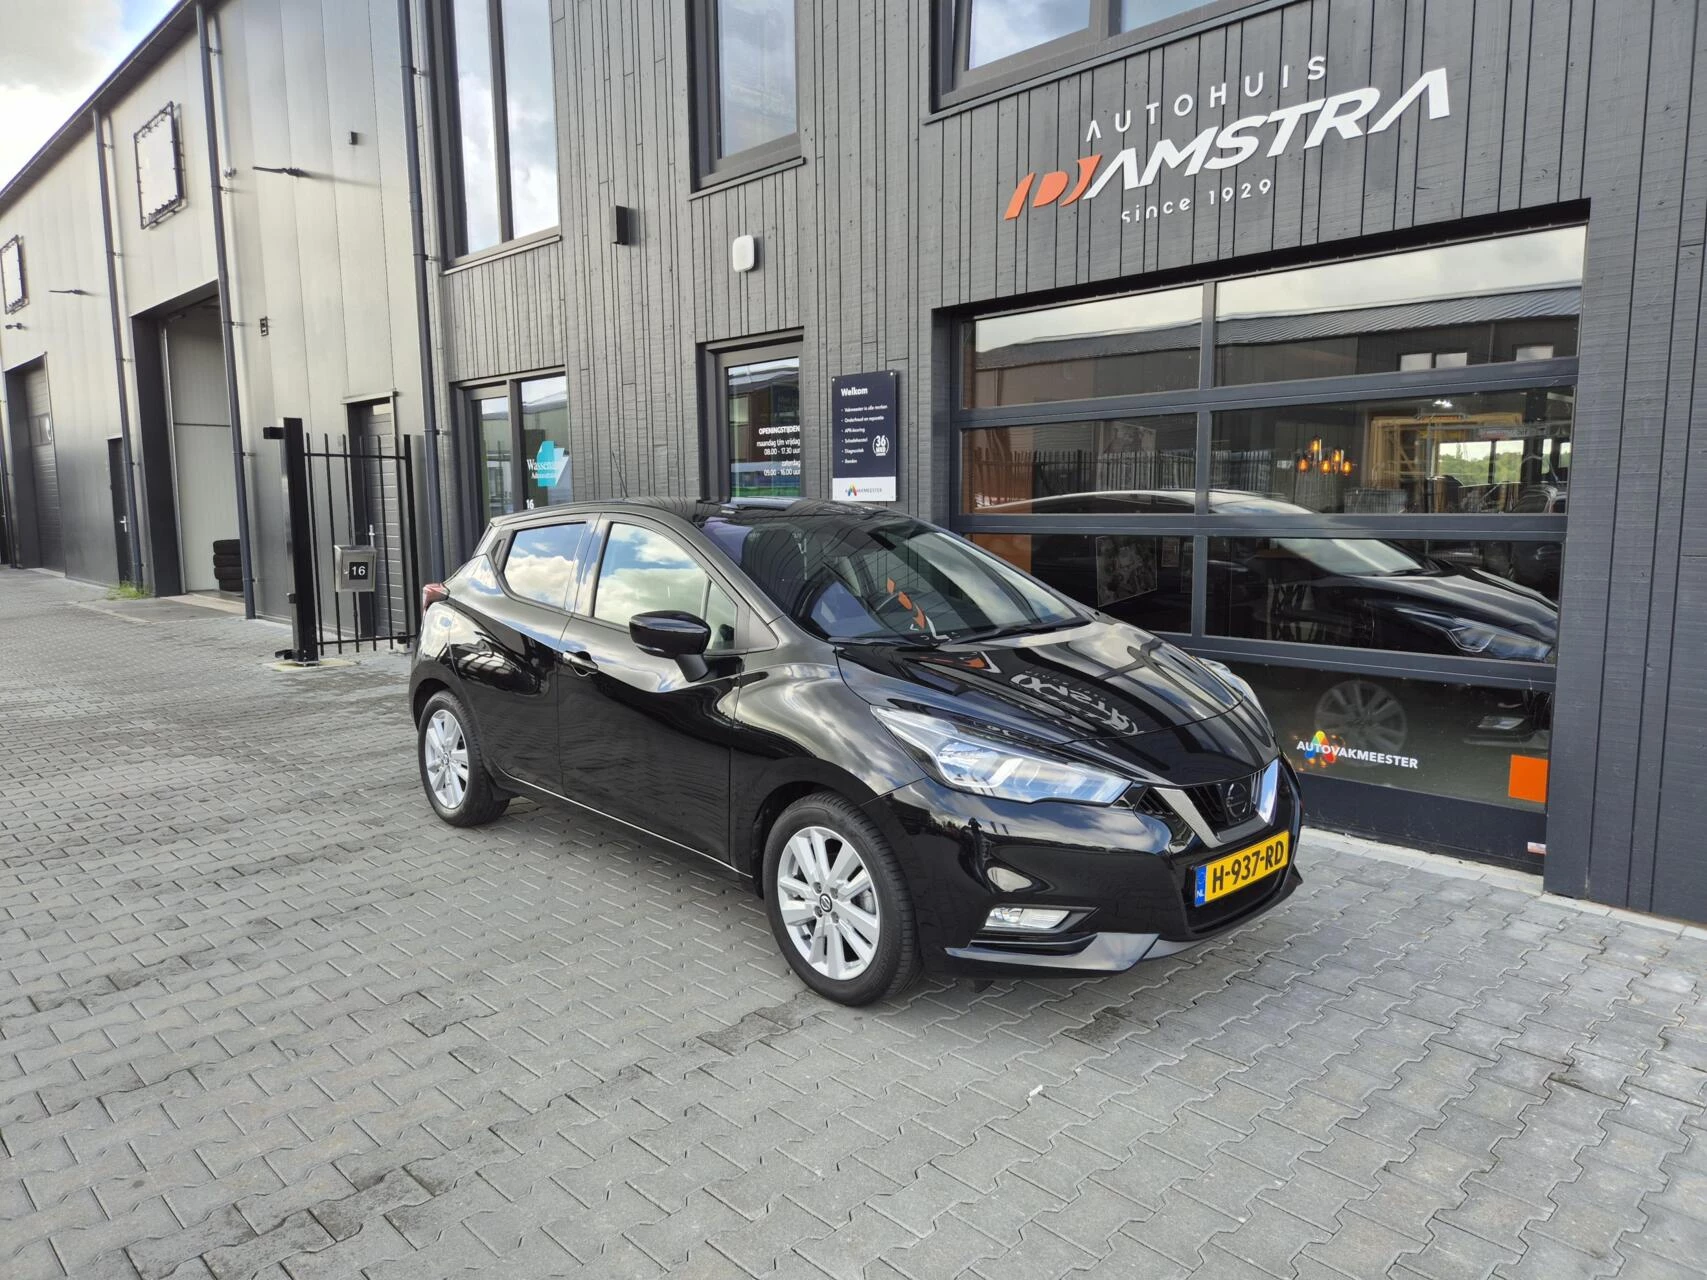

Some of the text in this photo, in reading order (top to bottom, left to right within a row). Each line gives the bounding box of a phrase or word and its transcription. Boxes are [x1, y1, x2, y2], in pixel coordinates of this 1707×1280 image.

[1086, 55, 1327, 142] AUTOHUIS
[1121, 178, 1272, 223] since 1929
[840, 387, 868, 397] Welkom
[756, 440, 777, 448] maandag
[875, 435, 886, 446] 36
[526, 499, 534, 510] 16
[351, 565, 366, 576] 16
[1296, 740, 1418, 769] AUTOVAKMEESTER
[1212, 840, 1285, 894] H-937-RD
